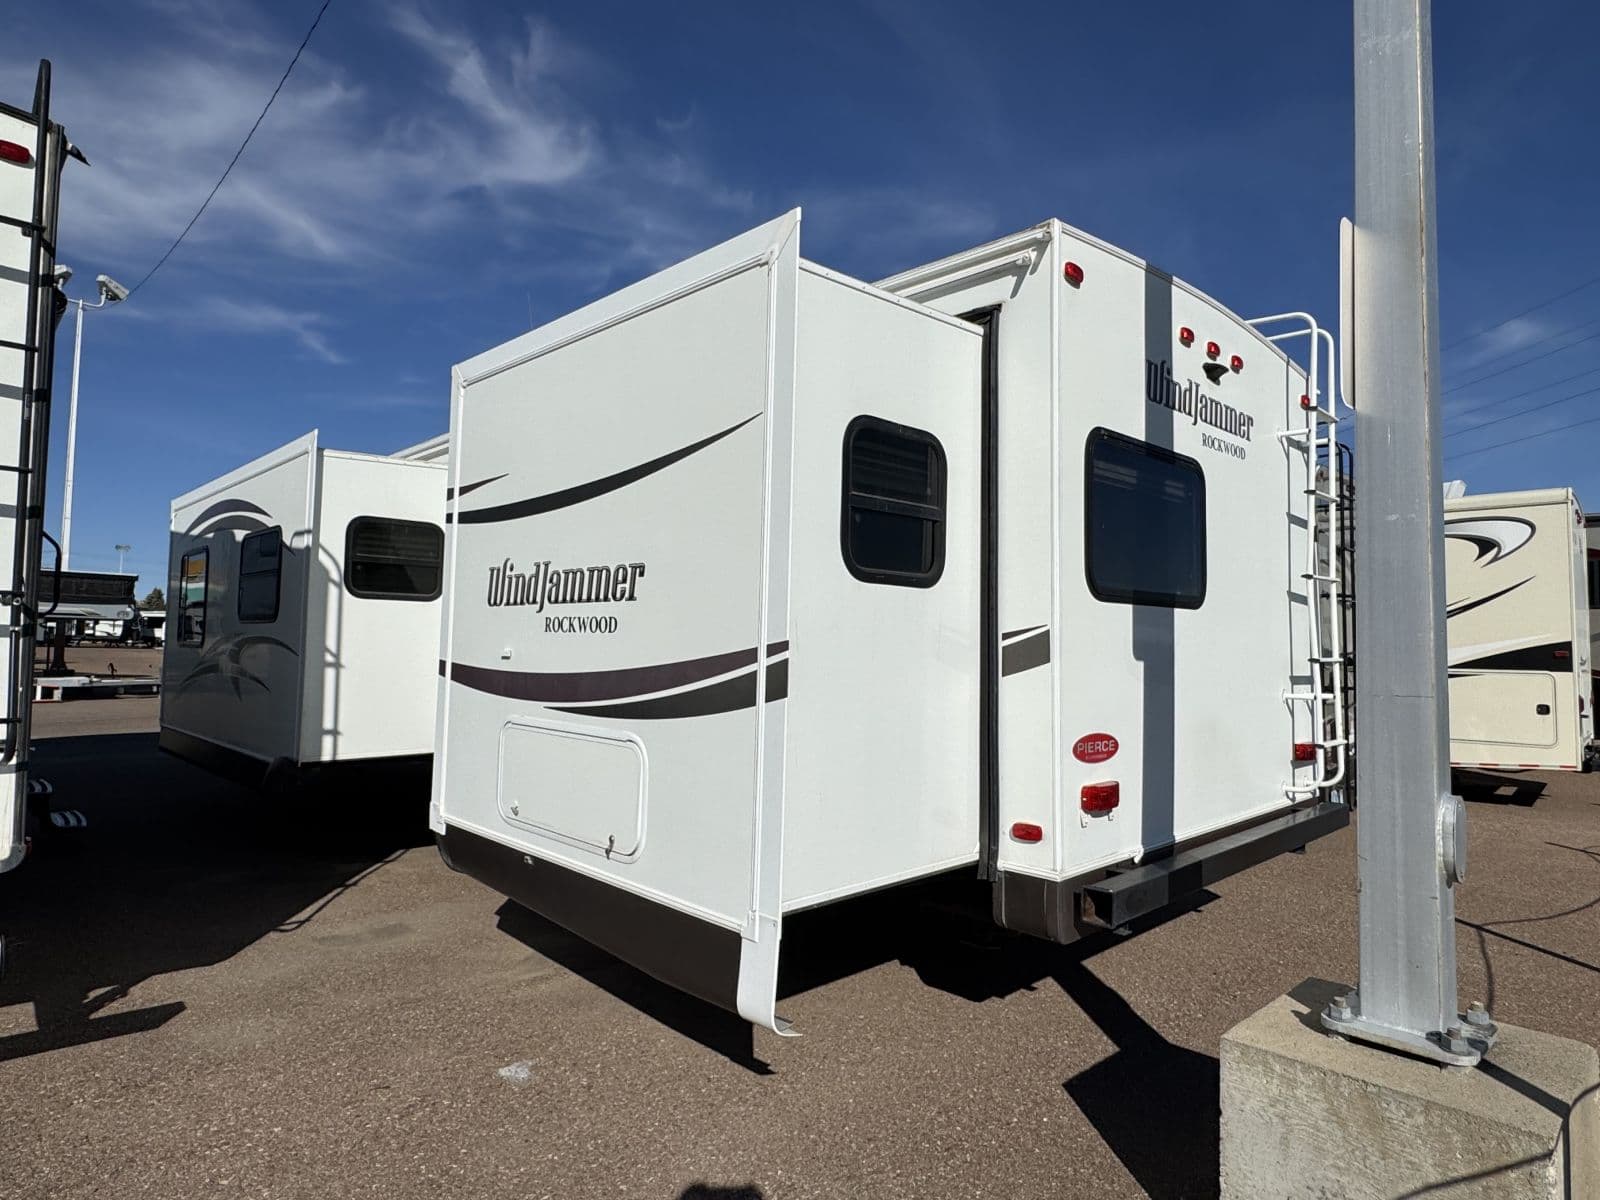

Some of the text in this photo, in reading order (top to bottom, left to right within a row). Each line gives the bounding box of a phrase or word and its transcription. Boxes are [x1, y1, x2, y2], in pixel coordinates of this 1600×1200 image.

[1146, 360, 1253, 441] WindJammer
[1202, 433, 1246, 459] ROCKWOOD
[487, 558, 645, 613] WindJammer
[544, 616, 618, 633] ROCKWOOD
[1077, 739, 1116, 754] PIERCE
